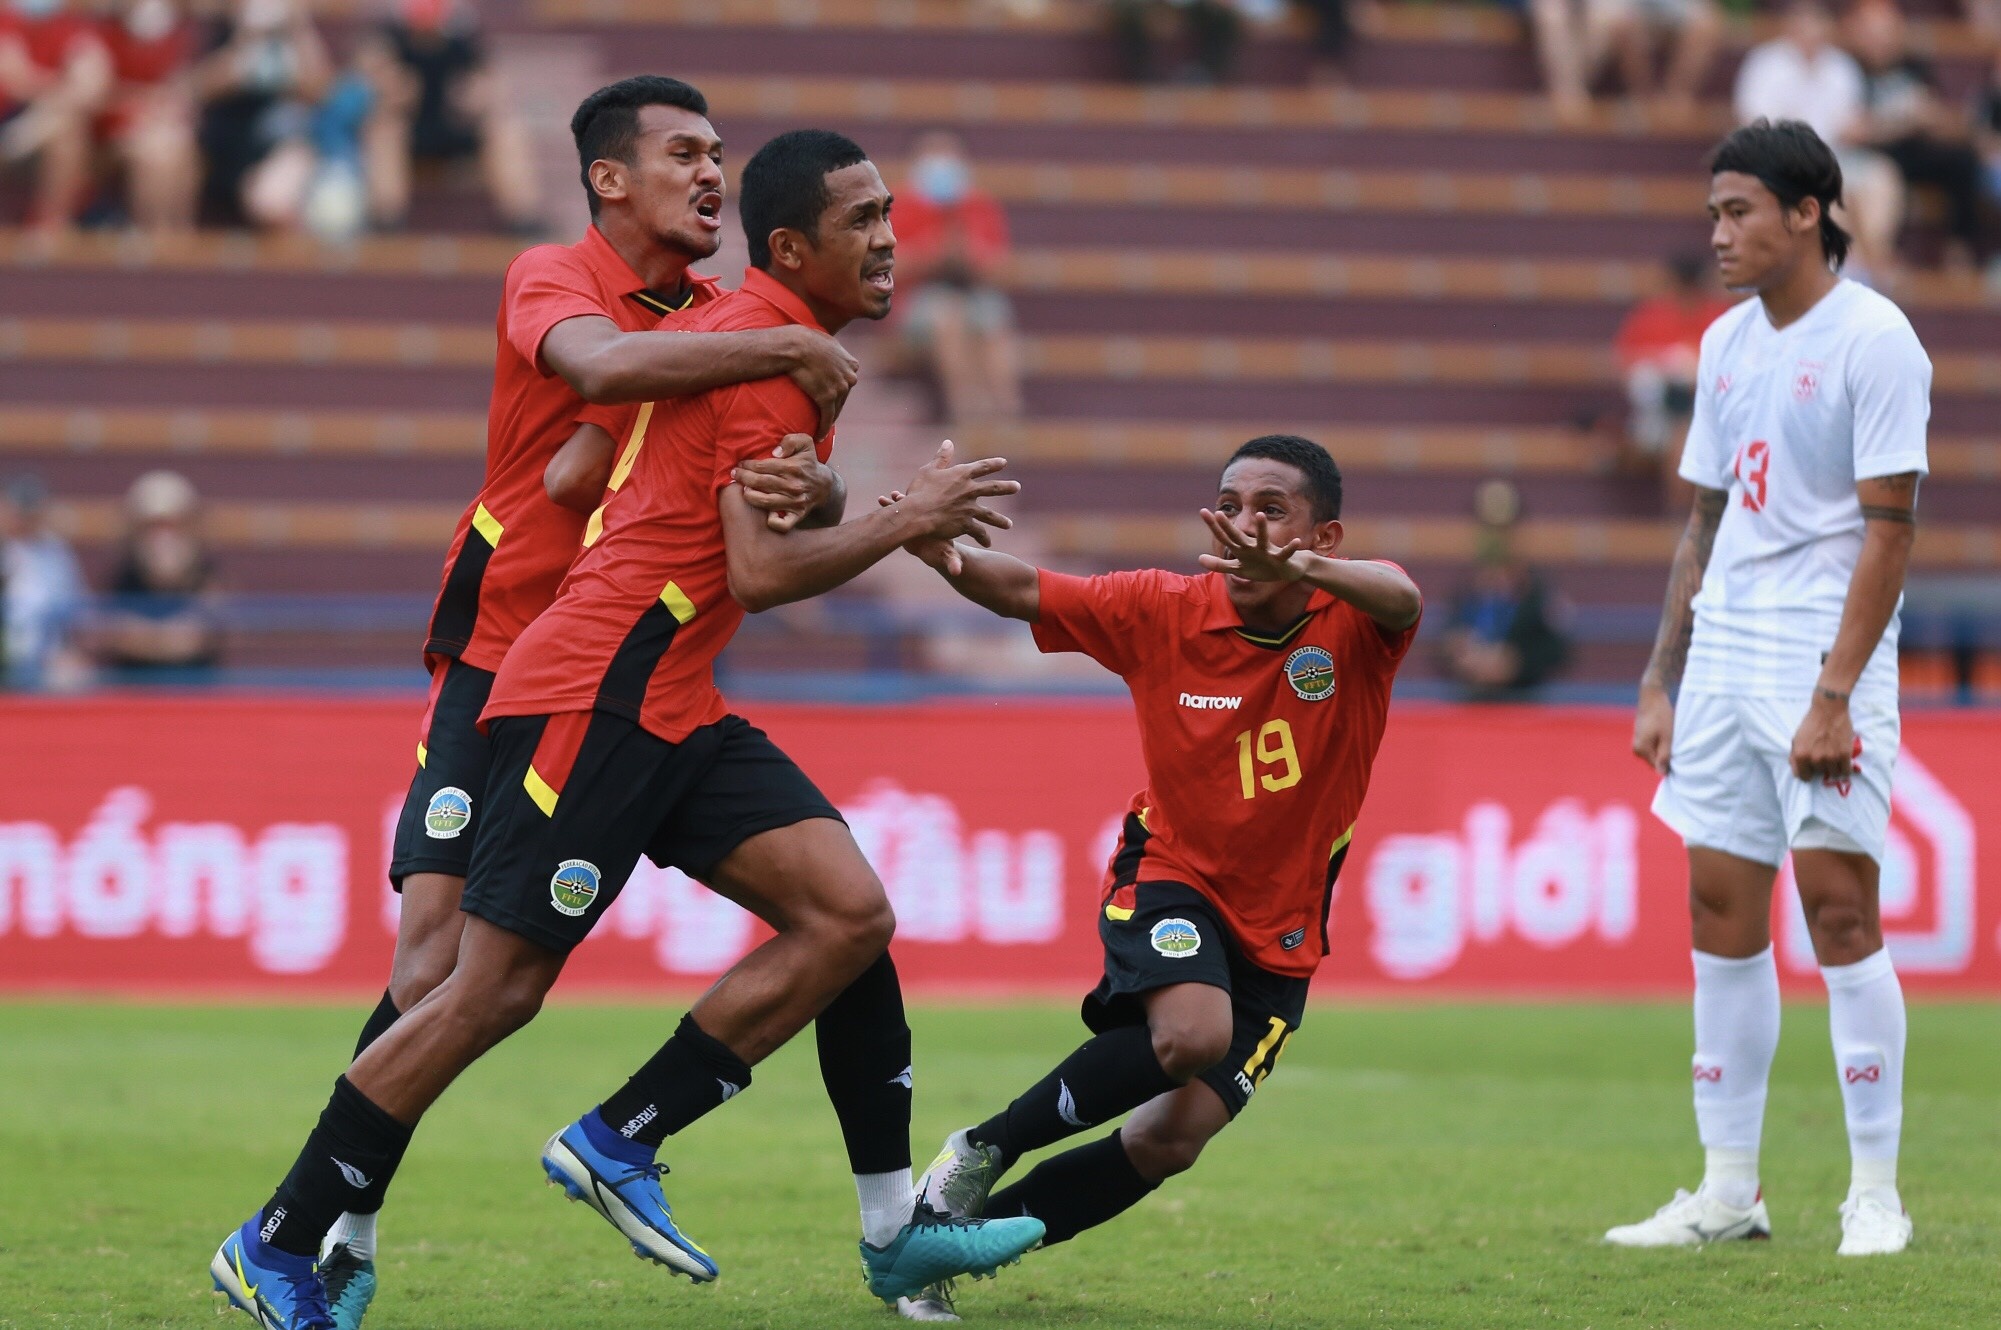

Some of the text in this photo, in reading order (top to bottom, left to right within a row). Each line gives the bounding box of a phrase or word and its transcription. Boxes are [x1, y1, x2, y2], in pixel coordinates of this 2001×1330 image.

[1733, 439, 1770, 515] 13
[1303, 680, 1328, 691] FFTL
[1178, 692, 1242, 710] narrow
[1235, 718, 1302, 800] 19
[562, 893, 582, 905] FFTL
